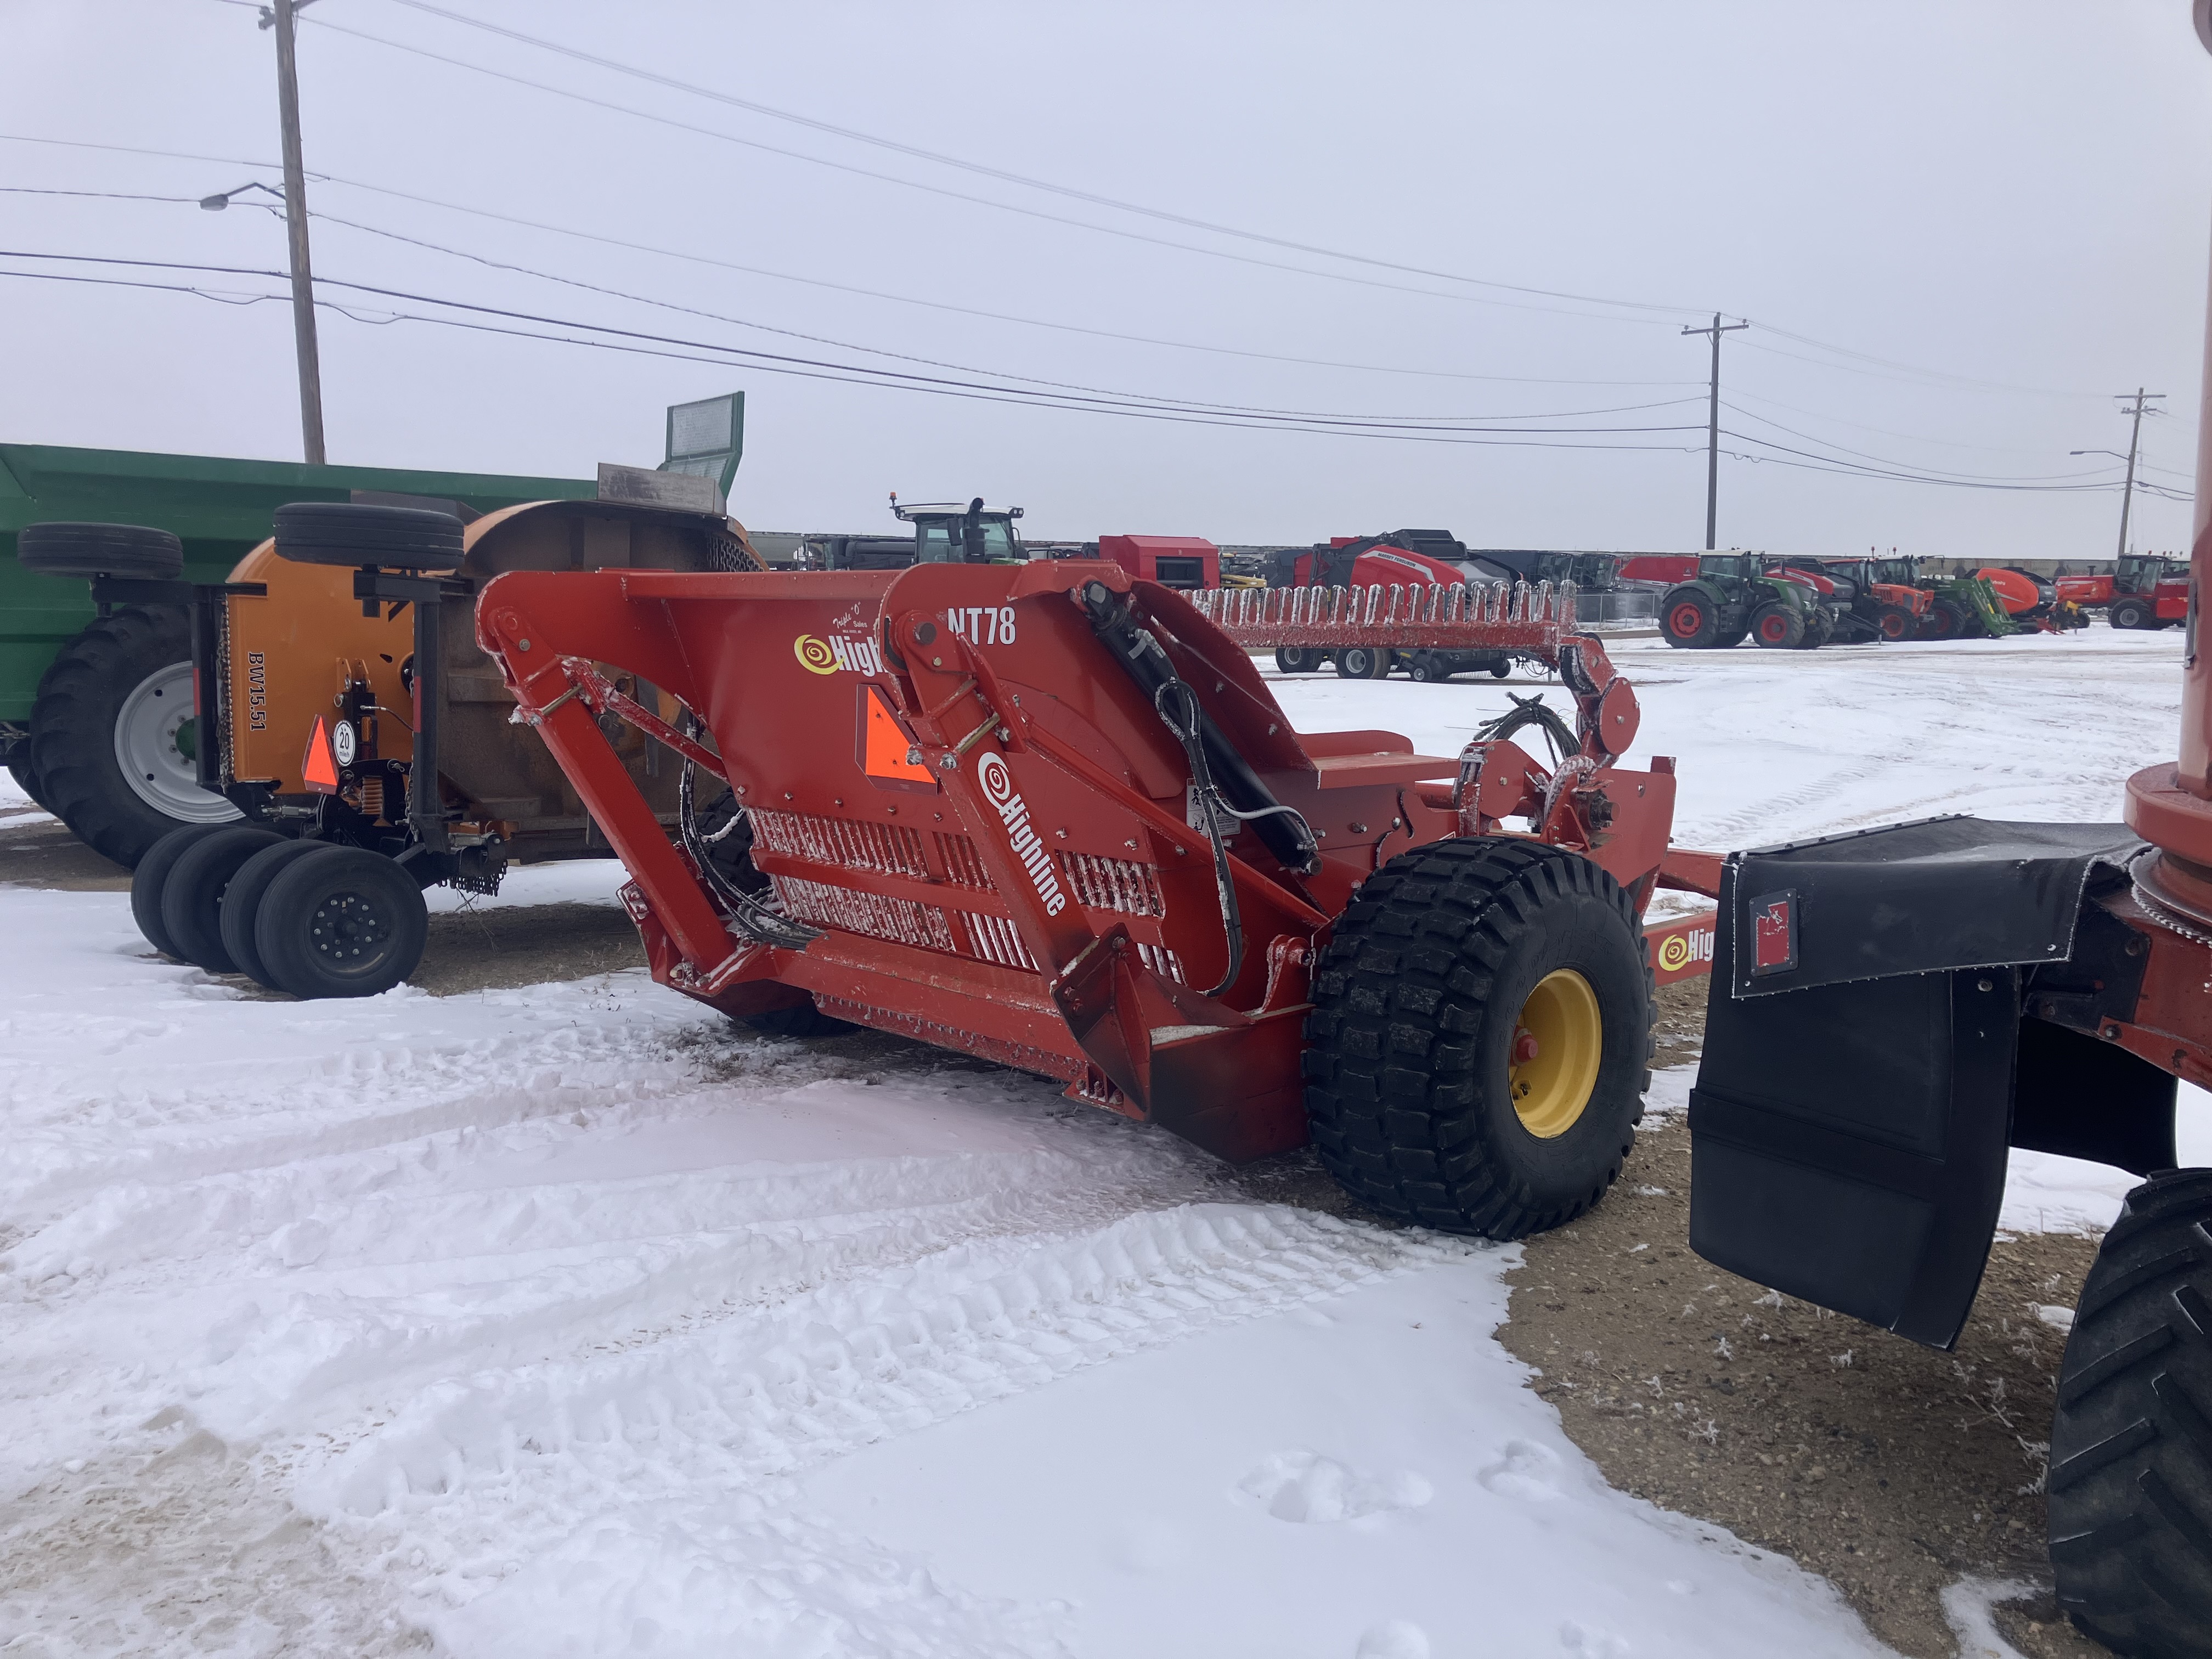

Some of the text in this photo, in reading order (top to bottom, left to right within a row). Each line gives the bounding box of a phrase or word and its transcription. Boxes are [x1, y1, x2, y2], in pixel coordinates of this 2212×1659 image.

[1394, 557, 1416, 567] FERGUSON
[832, 612, 851, 629] Triple
[947, 607, 1016, 645] NT78
[247, 651, 267, 731] BW15.51
[339, 731, 349, 749] 20
[998, 793, 1065, 917] Highline
